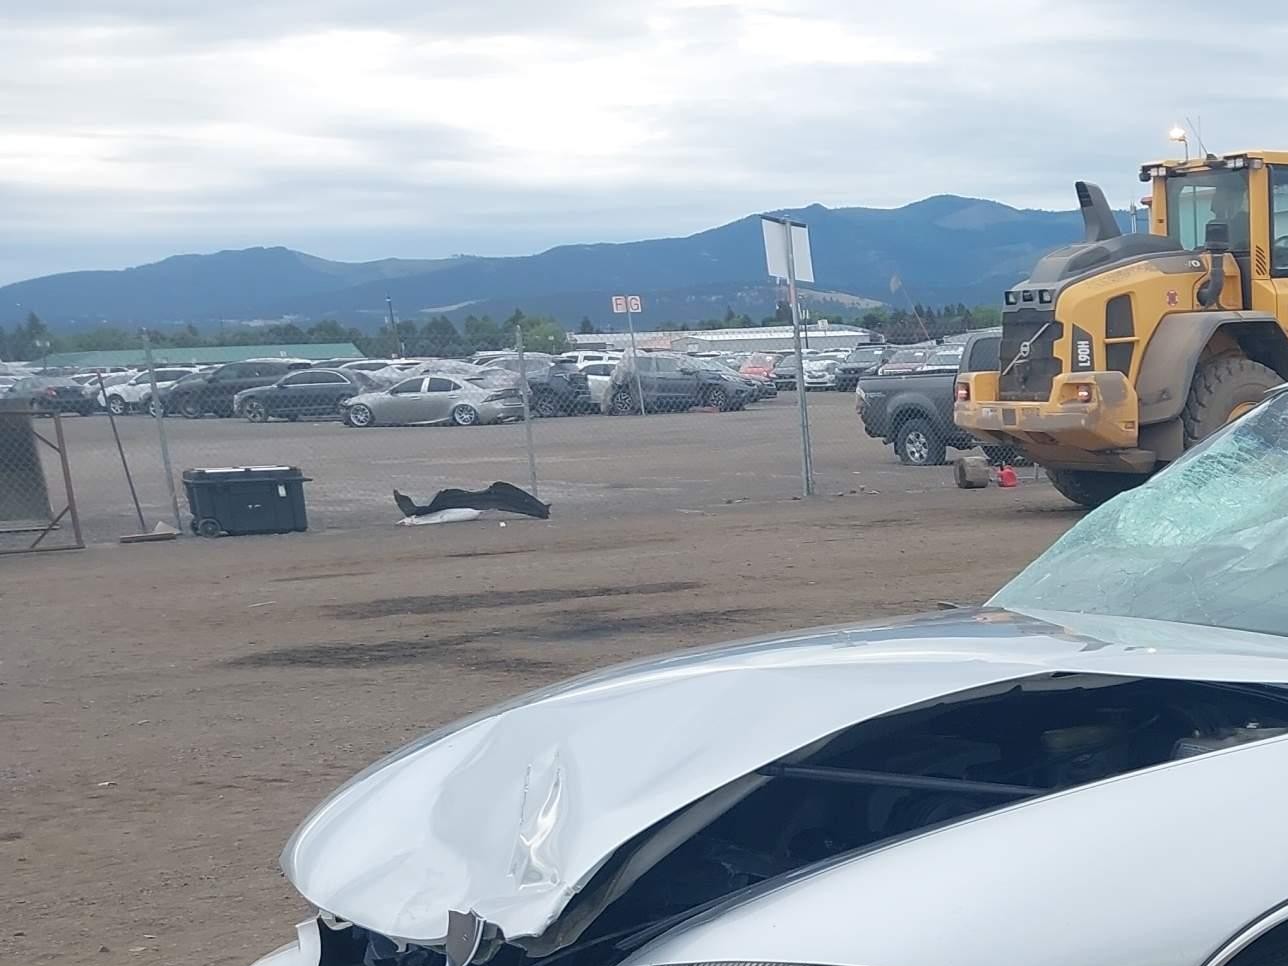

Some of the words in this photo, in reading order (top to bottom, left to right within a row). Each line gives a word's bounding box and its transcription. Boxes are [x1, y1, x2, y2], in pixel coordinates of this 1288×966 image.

[614, 297, 625, 311] F
[630, 297, 640, 311] G
[1077, 340, 1091, 367] L90H
